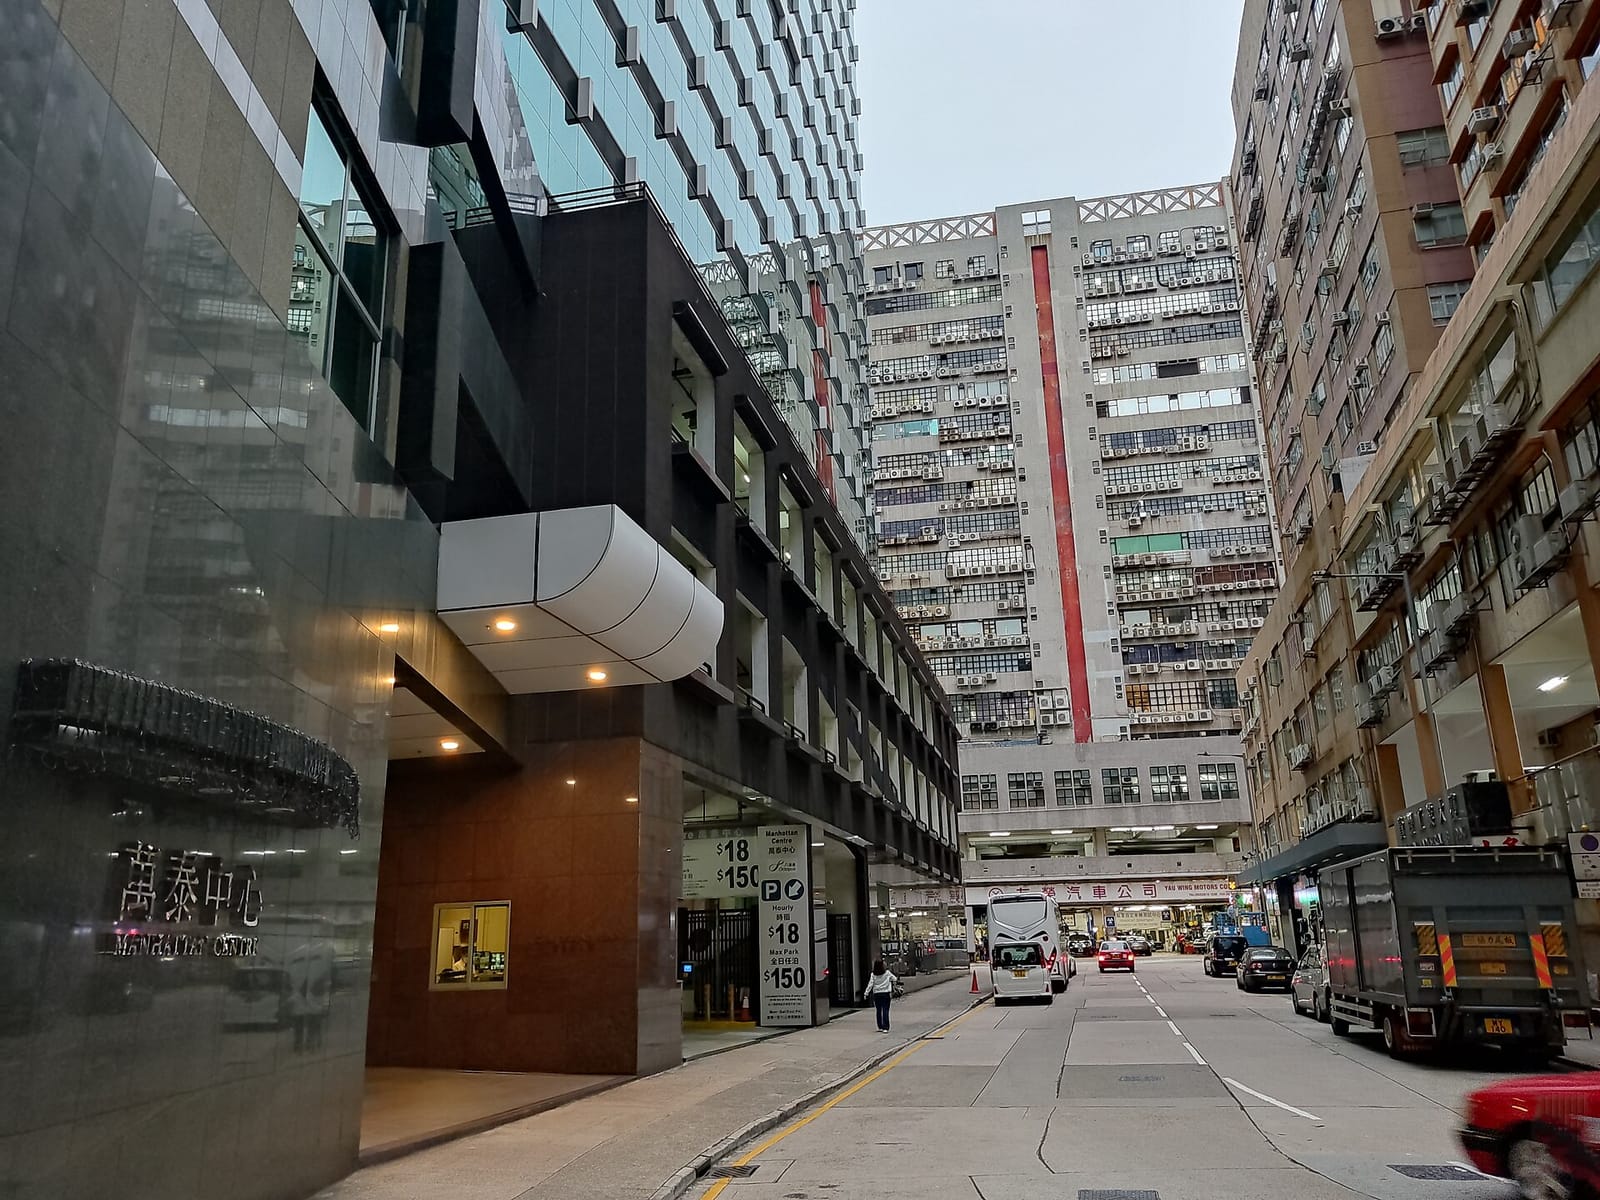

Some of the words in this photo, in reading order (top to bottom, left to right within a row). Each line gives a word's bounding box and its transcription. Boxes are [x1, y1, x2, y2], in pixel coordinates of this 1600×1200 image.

[716, 839, 749, 862] $18
[119, 839, 263, 927] 萬泰中心
[716, 865, 759, 889] $150
[765, 883, 778, 900] P
[768, 923, 800, 944] $18
[763, 967, 806, 989] $150
